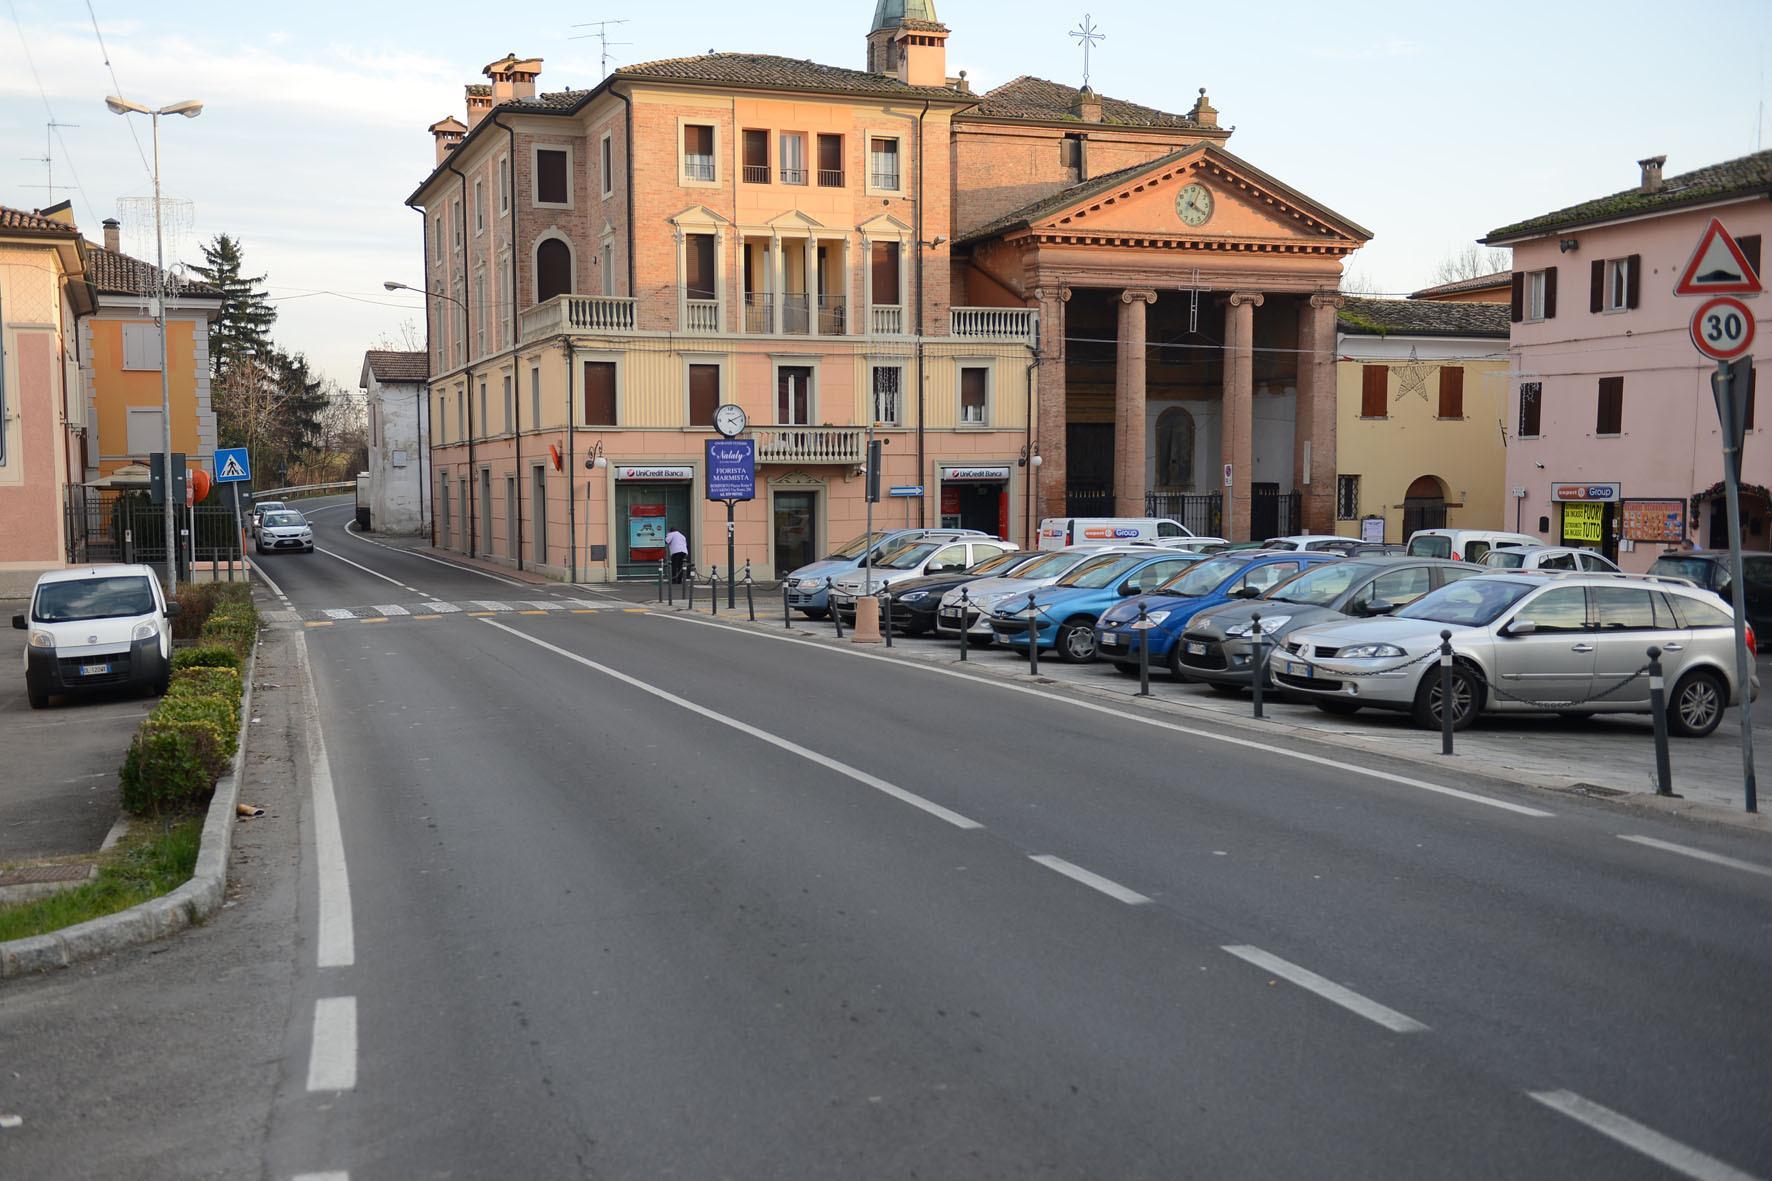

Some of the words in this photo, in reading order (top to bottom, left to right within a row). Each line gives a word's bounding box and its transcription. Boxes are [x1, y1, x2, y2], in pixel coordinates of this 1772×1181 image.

[1707, 313, 1742, 341] 30
[1589, 487, 1611, 496] Group
[1584, 504, 1602, 520] FUORI
[1583, 522, 1600, 538] TUTTO
